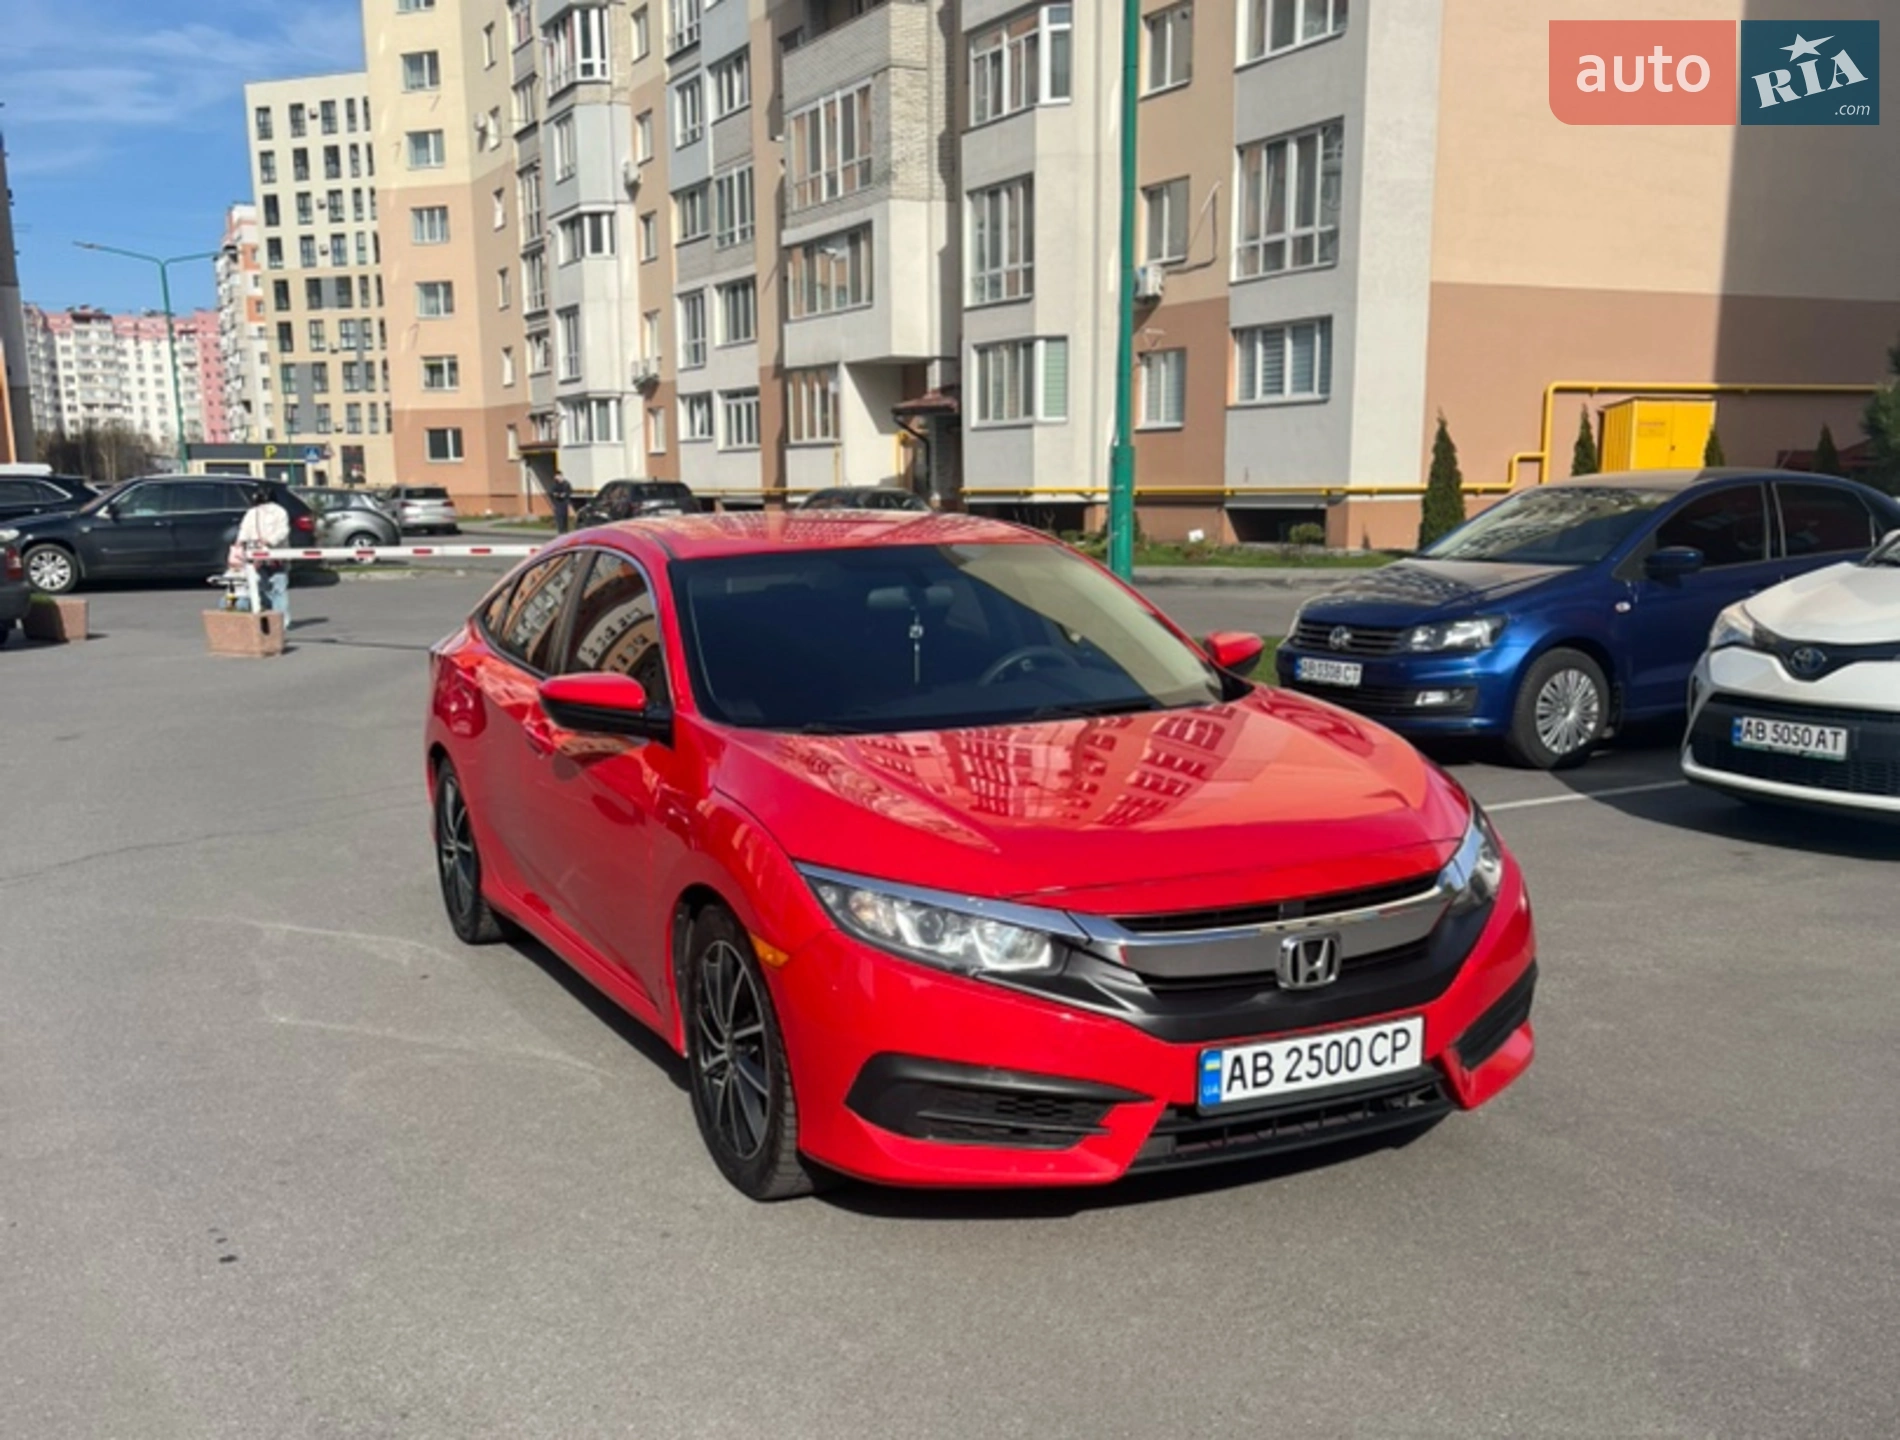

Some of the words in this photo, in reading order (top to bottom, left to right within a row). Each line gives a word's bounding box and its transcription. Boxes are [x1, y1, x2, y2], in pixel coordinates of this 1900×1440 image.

[264, 445, 277, 459] P
[1743, 719, 1767, 741] AB
[1770, 723, 1813, 748] 5050
[1815, 729, 1842, 750] AT
[1226, 1051, 1274, 1093] AB
[1284, 1036, 1362, 1084] 2500
[1369, 1028, 1411, 1067] CP
